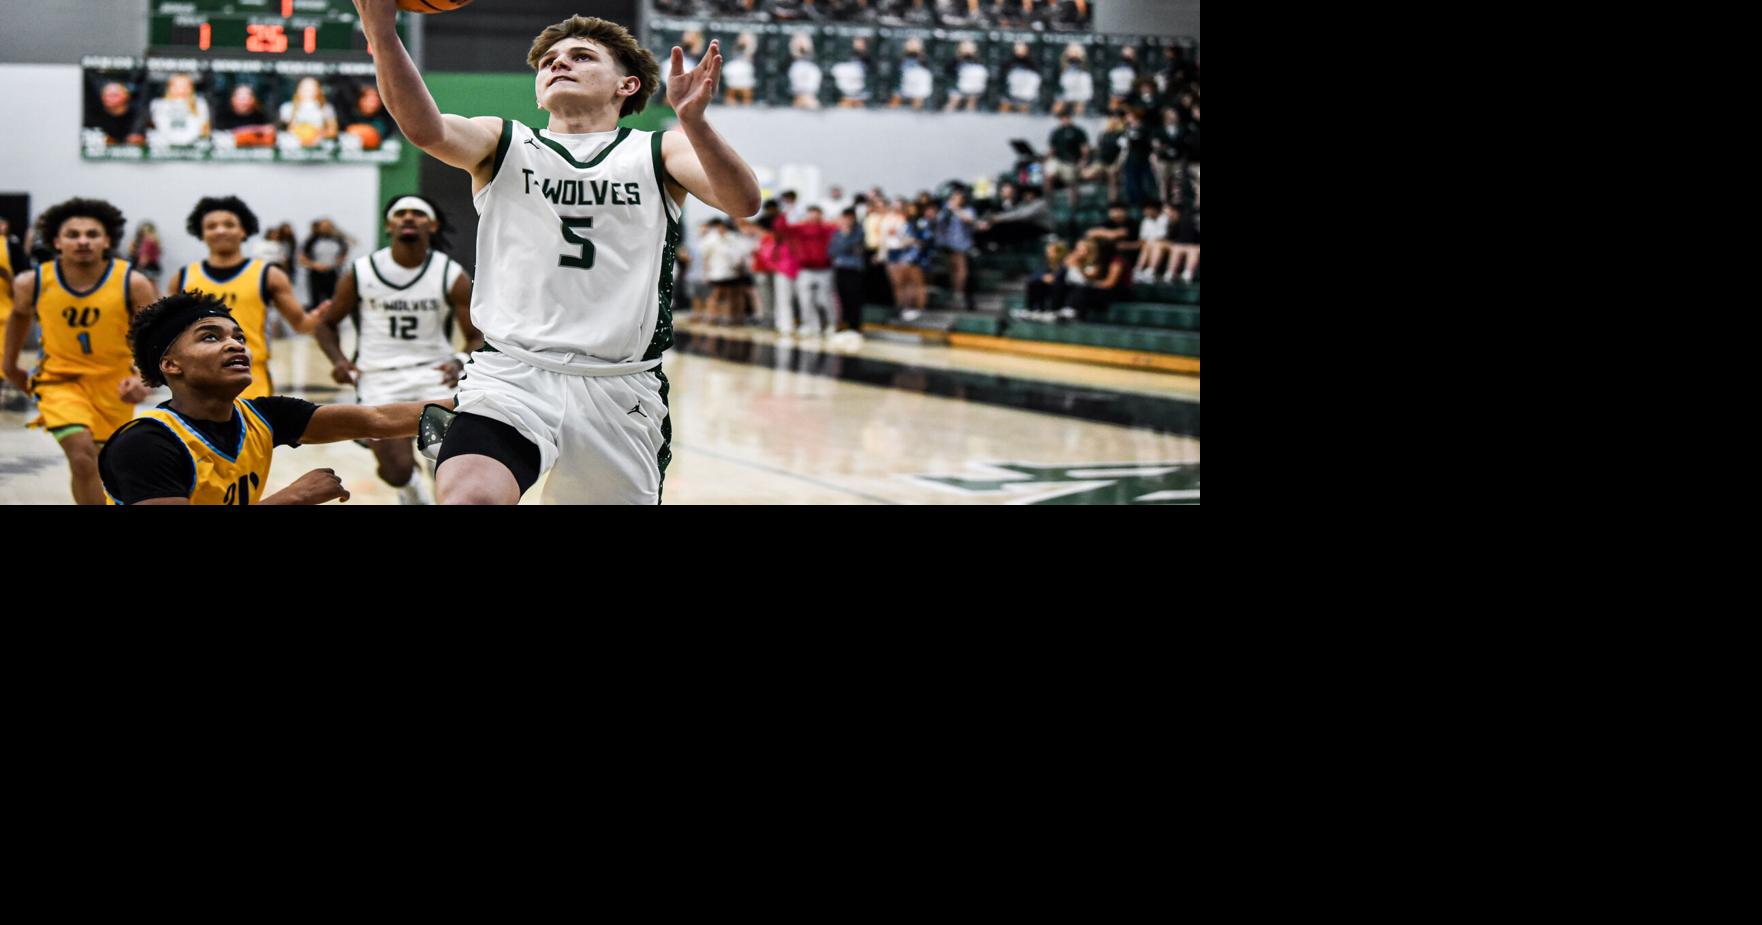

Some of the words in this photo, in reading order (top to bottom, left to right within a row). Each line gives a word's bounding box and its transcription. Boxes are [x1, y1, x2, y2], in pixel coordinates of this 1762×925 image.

[558, 215, 596, 270] 5
[389, 315, 419, 340] 12
[77, 331, 93, 355] 1
